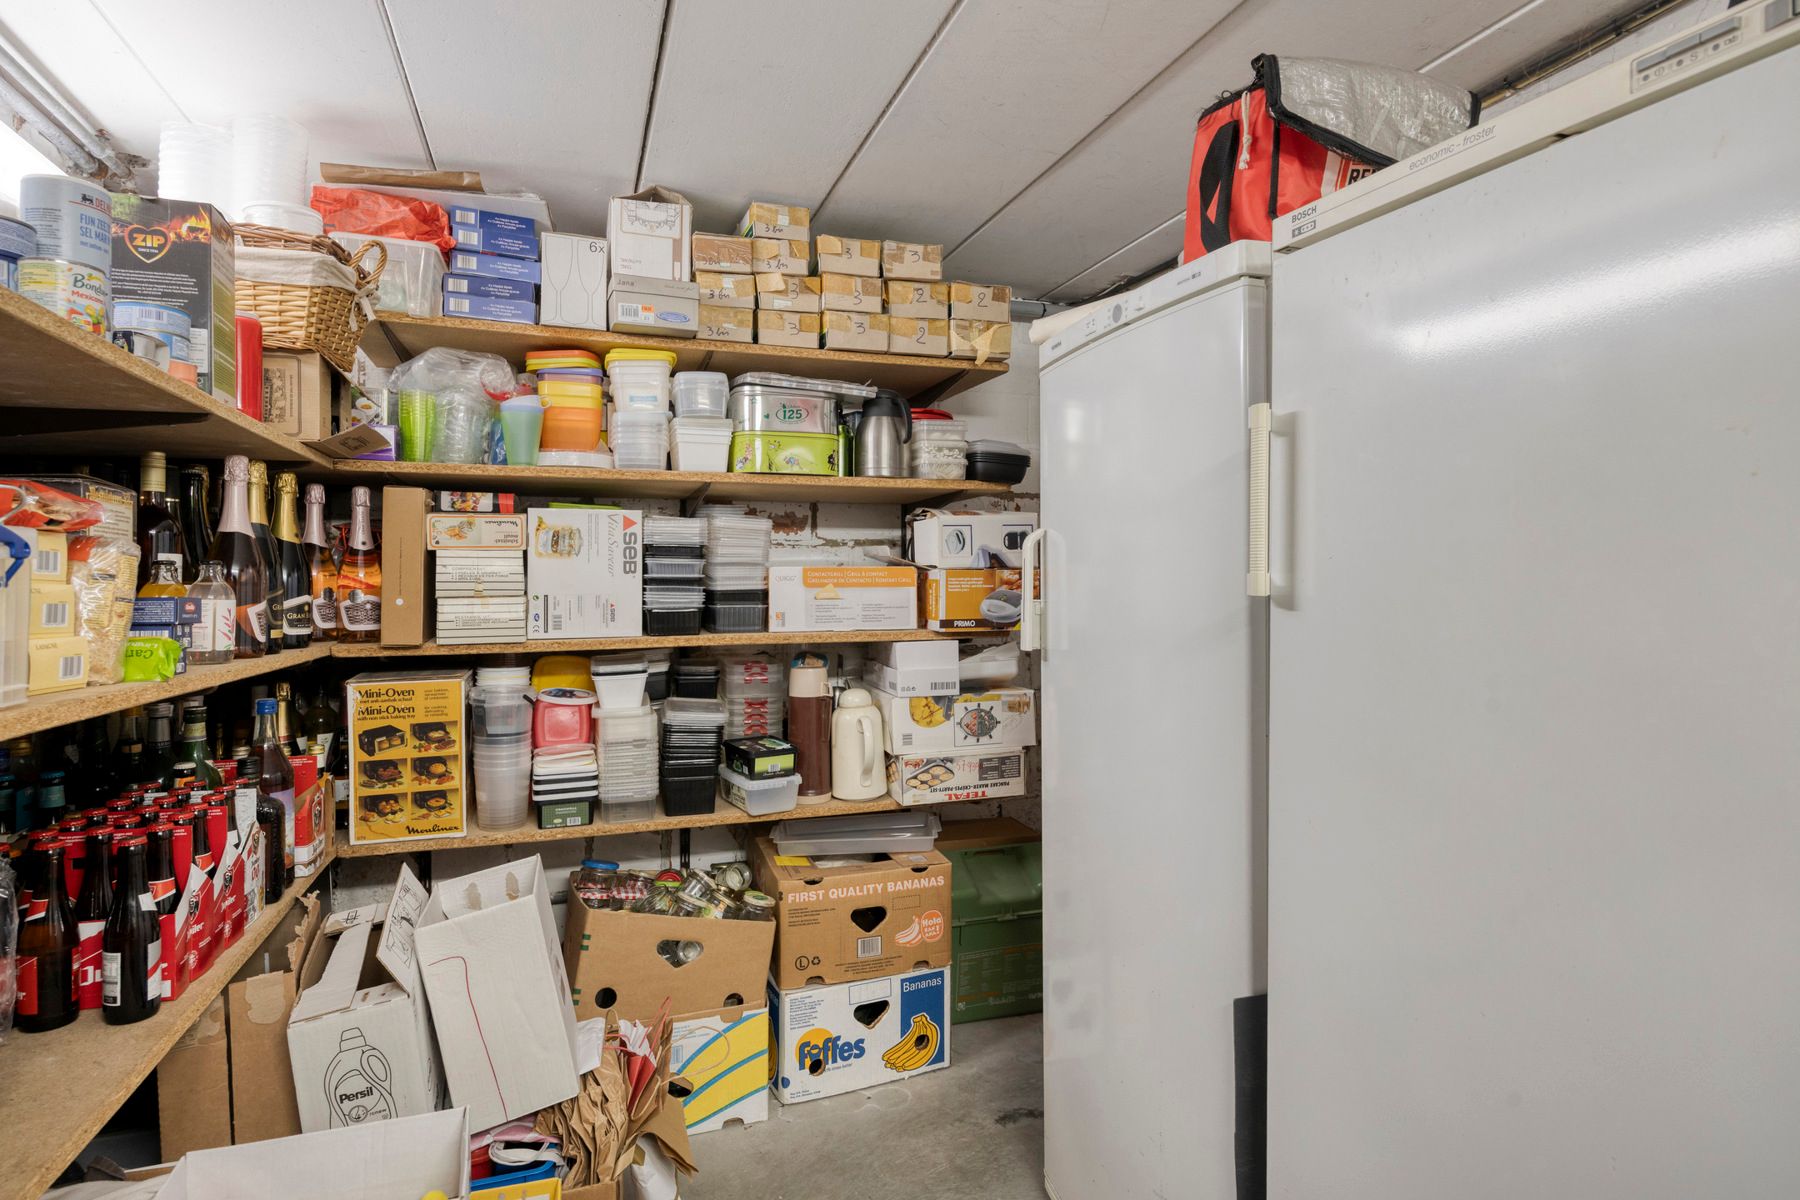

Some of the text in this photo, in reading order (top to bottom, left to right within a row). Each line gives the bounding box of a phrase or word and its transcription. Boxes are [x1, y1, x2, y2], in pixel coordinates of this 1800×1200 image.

[1409, 144, 1455, 171] economic
[1463, 124, 1496, 146] froster
[1291, 205, 1317, 224] BOSCH
[80, 226, 93, 239] SEL
[133, 234, 165, 247] ZIP
[589, 241, 605, 254] 6x
[845, 247, 852, 259] 3
[910, 250, 920, 262] 3
[790, 282, 799, 299] 3
[915, 287, 927, 302] 2
[853, 290, 862, 305] 3
[977, 292, 988, 307] 2
[707, 326, 713, 336] 3
[788, 322, 800, 335] 3
[854, 322, 866, 334] 3
[916, 326, 926, 344] 2
[358, 688, 415, 699] Mini-Oven
[358, 705, 415, 716] Mini-Oven
[944, 790, 988, 801] TEFAL
[787, 876, 944, 904] FIRST QUALITY BANANAS
[922, 917, 942, 927] Hola
[903, 977, 942, 992] Bananas
[339, 1086, 373, 1104] Persil
